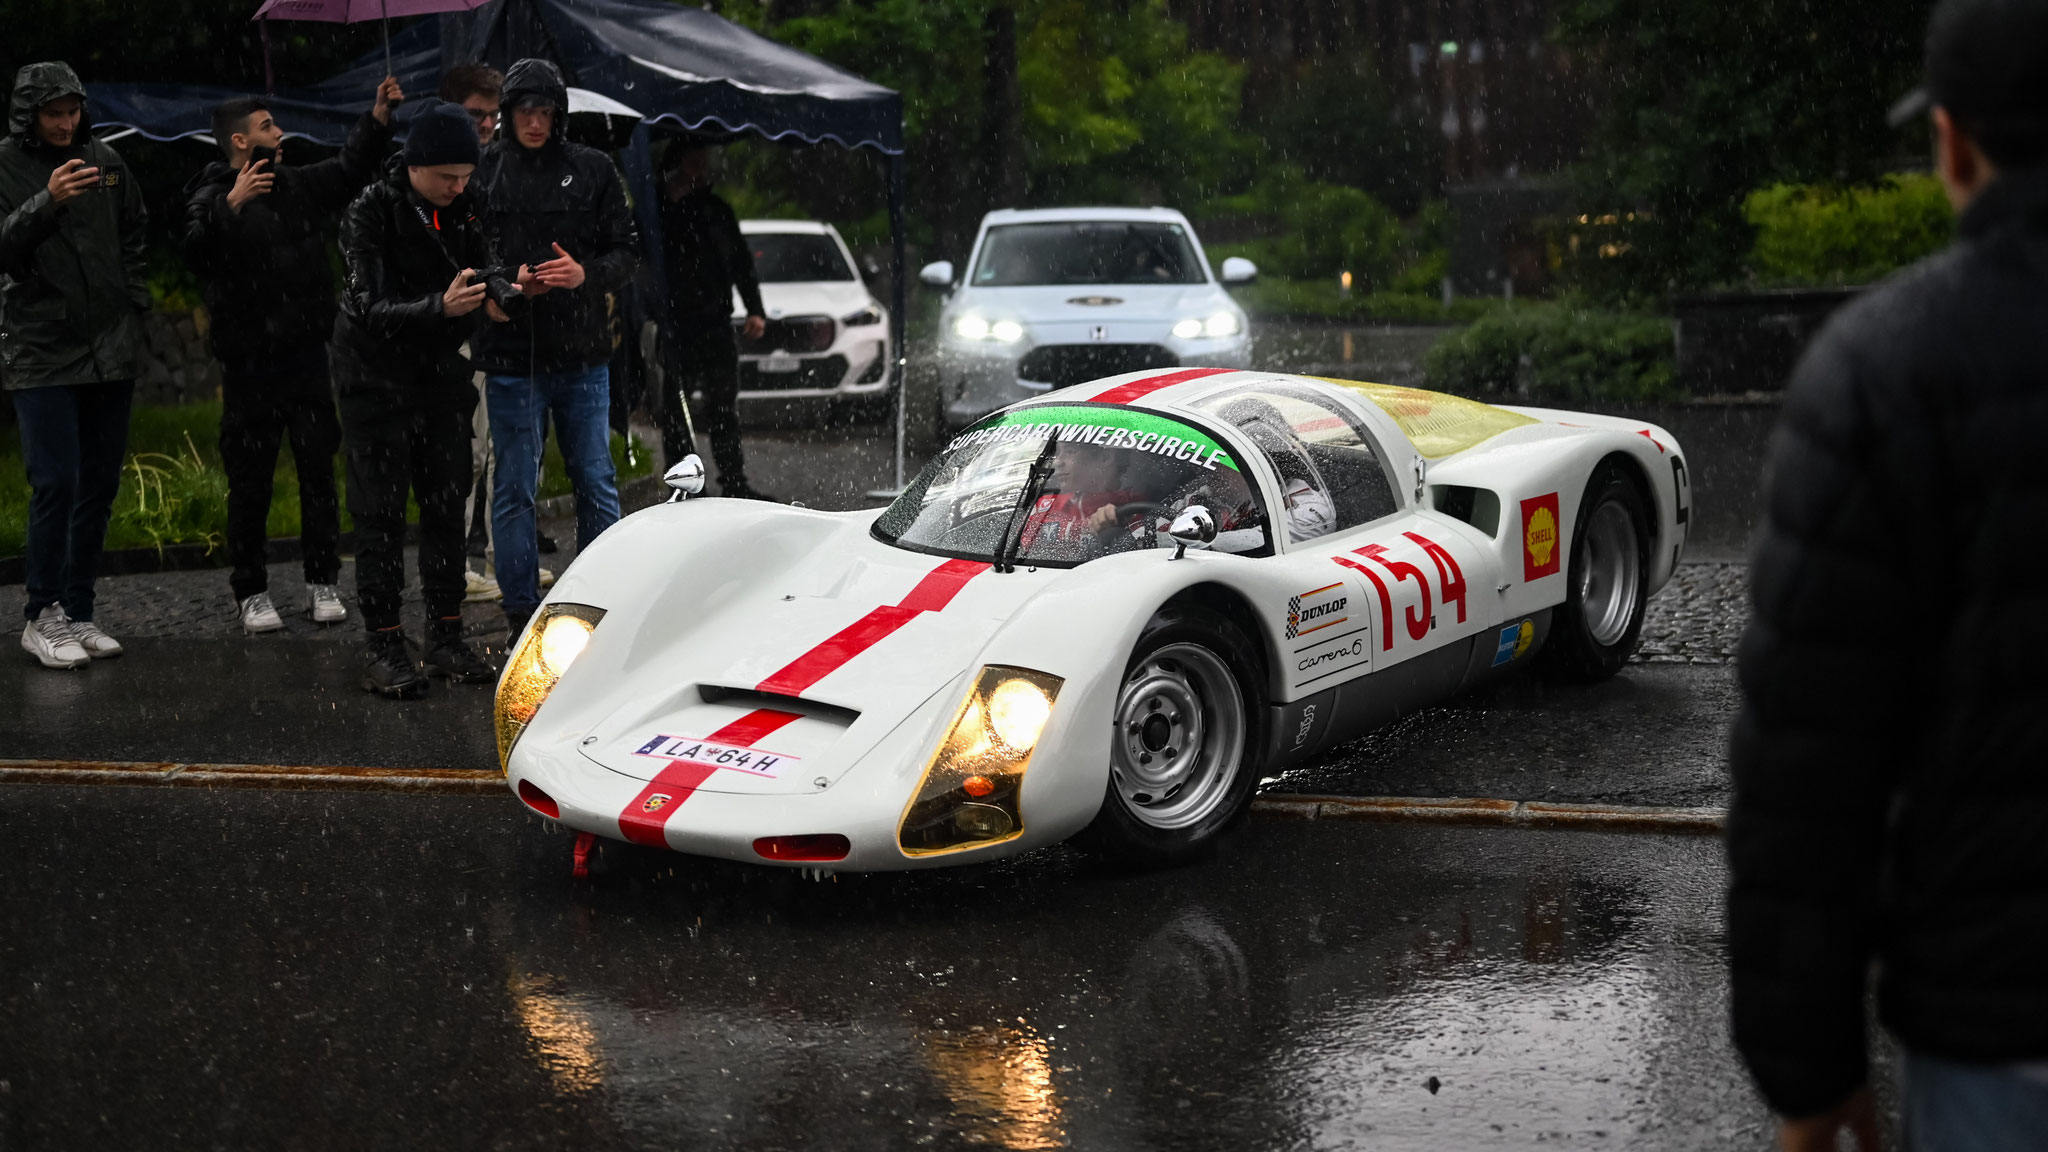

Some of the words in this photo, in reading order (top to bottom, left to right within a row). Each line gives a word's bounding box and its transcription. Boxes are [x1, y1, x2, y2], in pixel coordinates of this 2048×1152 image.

[942, 422, 1227, 471] SUPERCAROWNERSCIRCLE
[1531, 527, 1553, 546] SHELL
[1300, 597, 1348, 623] DUNLOP
[1330, 531, 1467, 652] 154
